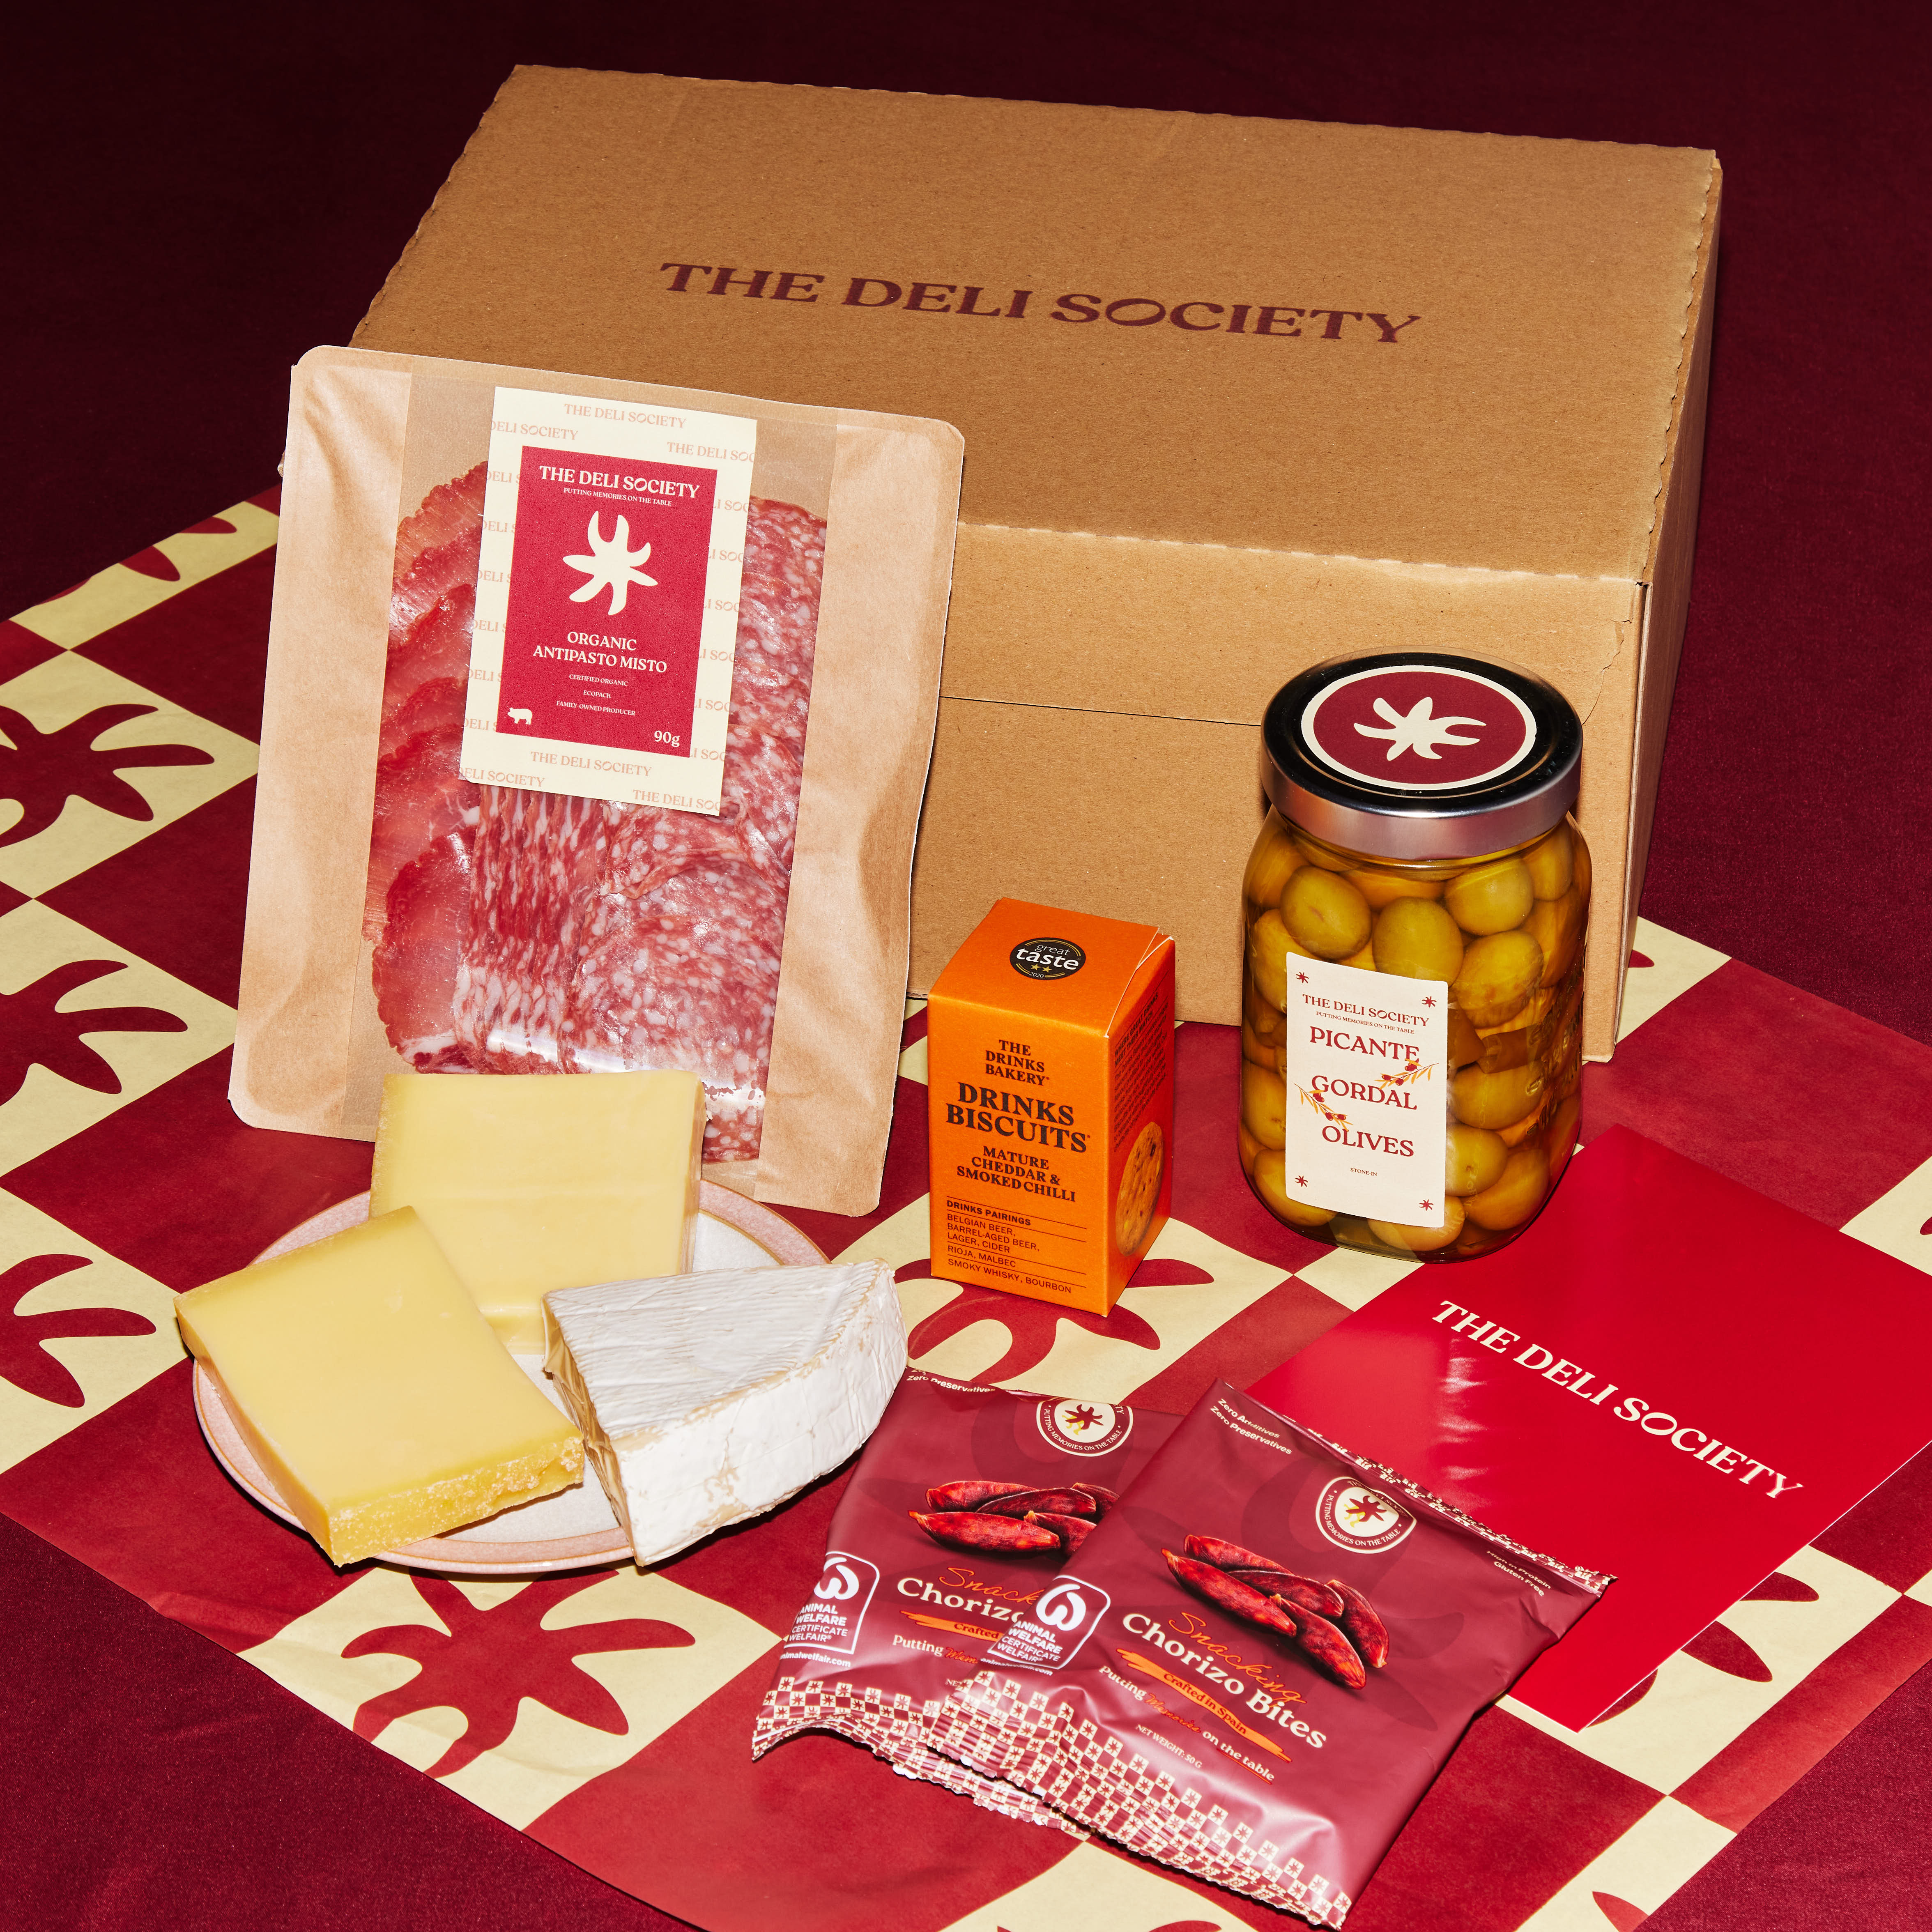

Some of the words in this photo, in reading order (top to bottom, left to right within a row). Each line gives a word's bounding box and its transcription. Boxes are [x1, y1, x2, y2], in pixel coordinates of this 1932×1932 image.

[660, 263, 825, 302] THE
[842, 278, 1033, 318] DELI
[1049, 292, 1421, 343] SOCIETY
[564, 404, 591, 417] THE
[595, 409, 625, 422] DELI
[628, 412, 686, 428] SOCIETY
[520, 424, 578, 440] SOCIETY
[667, 442, 694, 455] THE
[697, 446, 726, 459] DELI
[539, 466, 575, 483] THE
[579, 471, 619, 488] DELI
[623, 476, 699, 498] SOCIETY
[564, 488, 592, 496] PUTTING
[593, 492, 627, 500] MEMORIES
[567, 632, 637, 651] ORGANIC
[533, 645, 616, 666] ANTIPASTO
[620, 656, 667, 673] MISTO
[569, 674, 599, 682] CERTIFIED
[600, 678, 628, 686] ORGANIC
[583, 690, 611, 699] ECOPACK
[556, 701, 602, 711] FAMILY-OWNED
[603, 707, 635, 716] PRODUCER
[654, 730, 680, 747] 90g
[531, 751, 557, 764] THE
[561, 755, 591, 768] DELI
[594, 759, 652, 777] SOCIETY
[487, 771, 545, 787] SOCIETY
[633, 789, 659, 803] THE
[663, 794, 692, 807] DELI
[1016, 948, 1079, 970] taste
[1034, 945, 1070, 956] great
[1302, 994, 1330, 1008] THE
[1334, 1001, 1364, 1015] DELI
[1368, 1008, 1429, 1026] SOCIETY
[1316, 1011, 1341, 1020] PUTTING
[1342, 1017, 1373, 1026] MEMORIES
[999, 1039, 1031, 1056] THE
[1310, 1026, 1419, 1063] PICANTE
[985, 1050, 1044, 1072] DRINKS
[958, 1081, 1074, 1126] DRINKS
[1311, 1075, 1417, 1110] GORDAL
[1322, 1125, 1414, 1157] OLIVES
[982, 1145, 1049, 1170] MATURE
[971, 1157, 1046, 1183] CHEDDAR
[1050, 1174, 1060, 1185] &
[1350, 1167, 1377, 1177] STONE-IN
[957, 1166, 1021, 1189] SMOKED
[1024, 1181, 1076, 1202] CHILLI
[947, 1200, 983, 1214] DRINKS
[985, 1210, 1031, 1226] PAIRINGS
[947, 1214, 986, 1229] BELGIAN
[989, 1224, 1016, 1237] BEER,
[948, 1223, 1010, 1243] BARREL-AGED
[1013, 1239, 1040, 1251] BEER,
[948, 1232, 980, 1246] LAGER,
[982, 1241, 1010, 1253] CIDER
[948, 1245, 976, 1258] RIOJA,
[979, 1253, 1016, 1267] MALBEC
[948, 1258, 981, 1272] SMOKY
[983, 1267, 1023, 1283] WHISKY,
[1026, 1277, 1071, 1293] BOURBON
[1432, 1300, 1520, 1353] THE
[1513, 1344, 1619, 1405] DELI
[1613, 1397, 1804, 1498] SOCIETY
[1044, 1409, 1053, 1431] PUTTING
[1050, 1431, 1083, 1450] MEMORIES
[1093, 1442, 1108, 1450] THE
[1106, 1430, 1122, 1444] TABLE
[1210, 1406, 1230, 1425] Zero
[1230, 1423, 1292, 1454] Preservatives
[1218, 1398, 1238, 1417] Zero
[1237, 1415, 1280, 1438] Additives
[1324, 1495, 1334, 1520] PUTTING
[1326, 1520, 1354, 1544] MEMORIES
[1381, 1529, 1401, 1543] TABLE
[1494, 1561, 1524, 1580] Gluten
[1525, 1579, 1544, 1596] Free
[1518, 1569, 1551, 1589] Protein
[796, 1613, 847, 1626] WELFARE
[799, 1603, 838, 1615] ANIMAL
[792, 1624, 848, 1637] CERTIFICATE
[954, 1623, 999, 1640] Crafted
[1008, 1628, 1063, 1654] WELFARE
[1013, 1621, 1056, 1643] ANIMAL
[892, 1635, 944, 1657] Putting
[1001, 1636, 1060, 1661] CERTIFICATE
[780, 1652, 851, 1667] nimalwelfair.com
[1168, 1612, 1308, 1708] Snacking
[1122, 1612, 1244, 1695] Chorizo
[1246, 1688, 1327, 1748] Bites
[1163, 1673, 1205, 1701] Crafted
[1204, 1698, 1217, 1710] in
[1217, 1707, 1247, 1735] Spain
[1099, 1665, 1147, 1702] Putting
[1145, 1693, 1201, 1733] Memories
[1203, 1731, 1219, 1746] on
[1221, 1743, 1242, 1760] the
[1242, 1757, 1275, 1781] table
[1136, 1724, 1153, 1736] NET
[1151, 1734, 1185, 1758] WEIGHT:
[1182, 1753, 1196, 1764] 50
